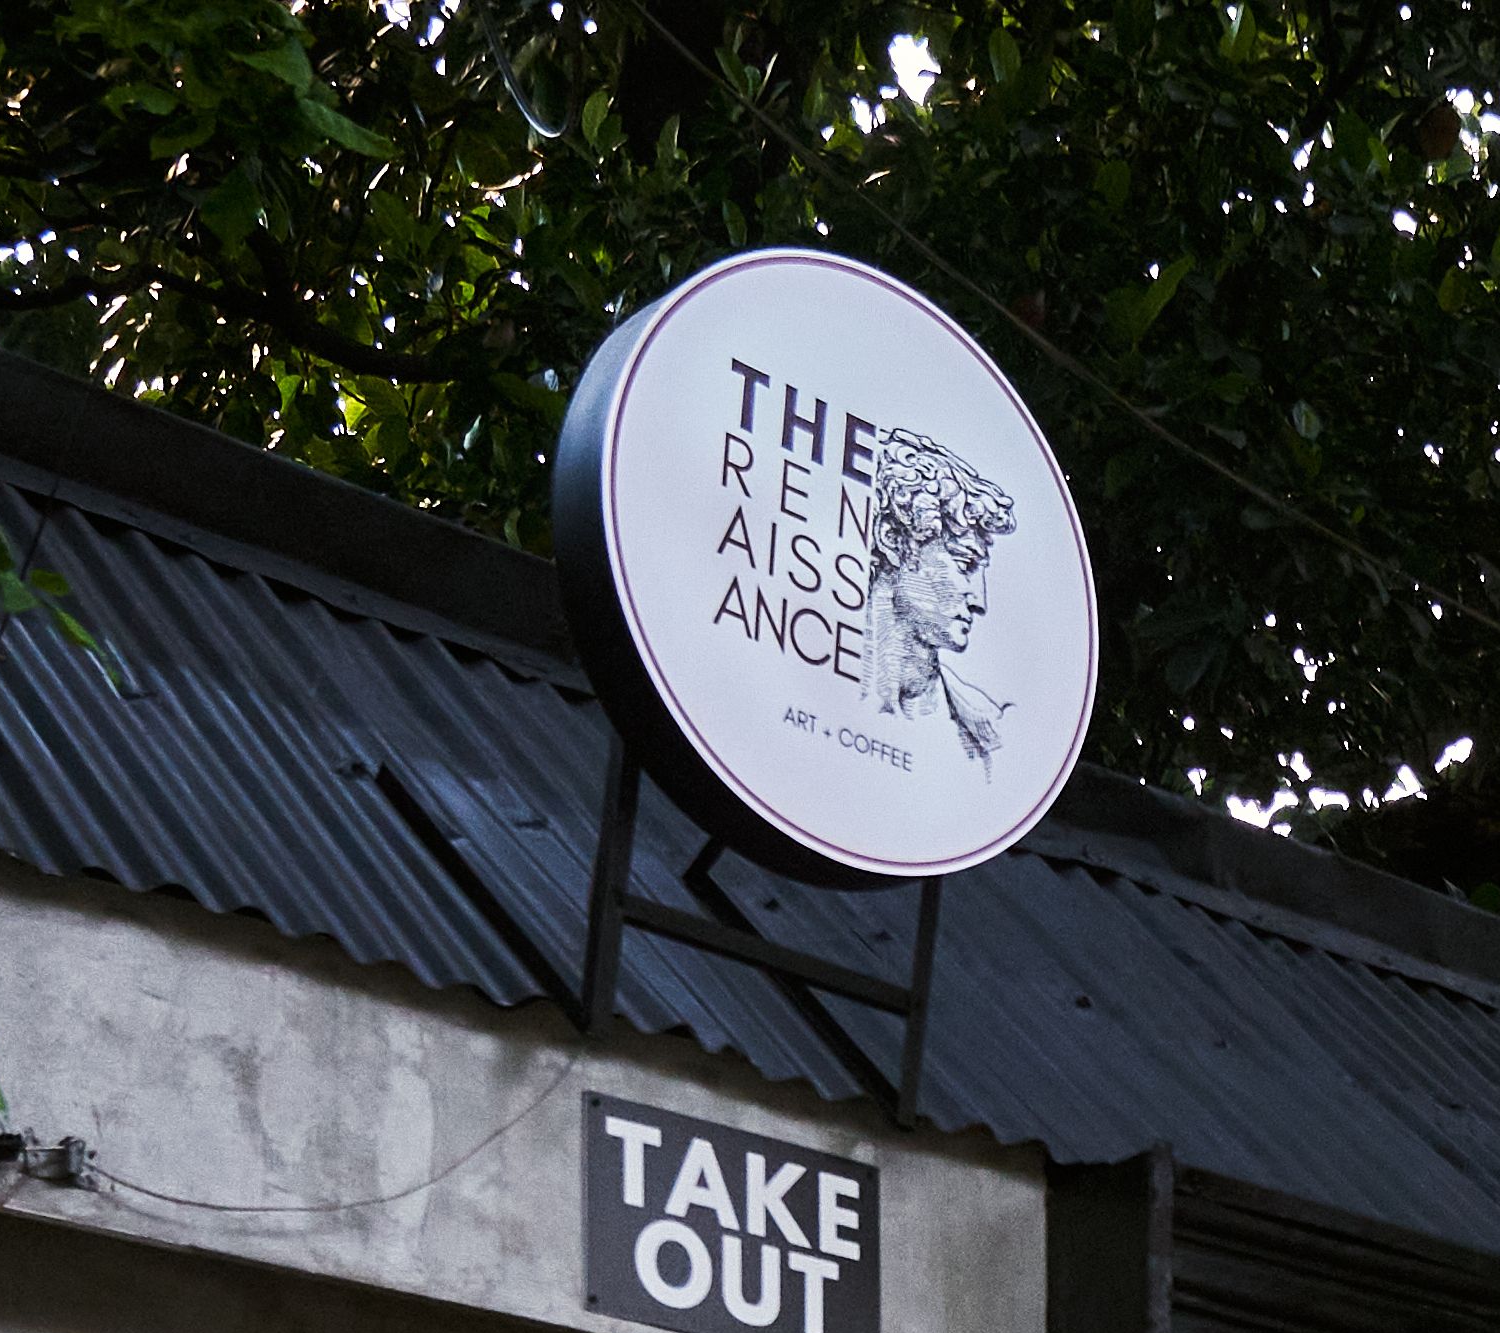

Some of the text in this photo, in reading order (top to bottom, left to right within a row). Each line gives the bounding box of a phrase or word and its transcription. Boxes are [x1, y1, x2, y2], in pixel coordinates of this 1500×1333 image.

[731, 357, 877, 487] THE
[722, 432, 871, 551] REN
[717, 504, 867, 612] AISS
[713, 575, 864, 684] ANCE
[782, 705, 817, 735] ART
[838, 726, 913, 772] COFFEE
[604, 1115, 861, 1262] TAKE
